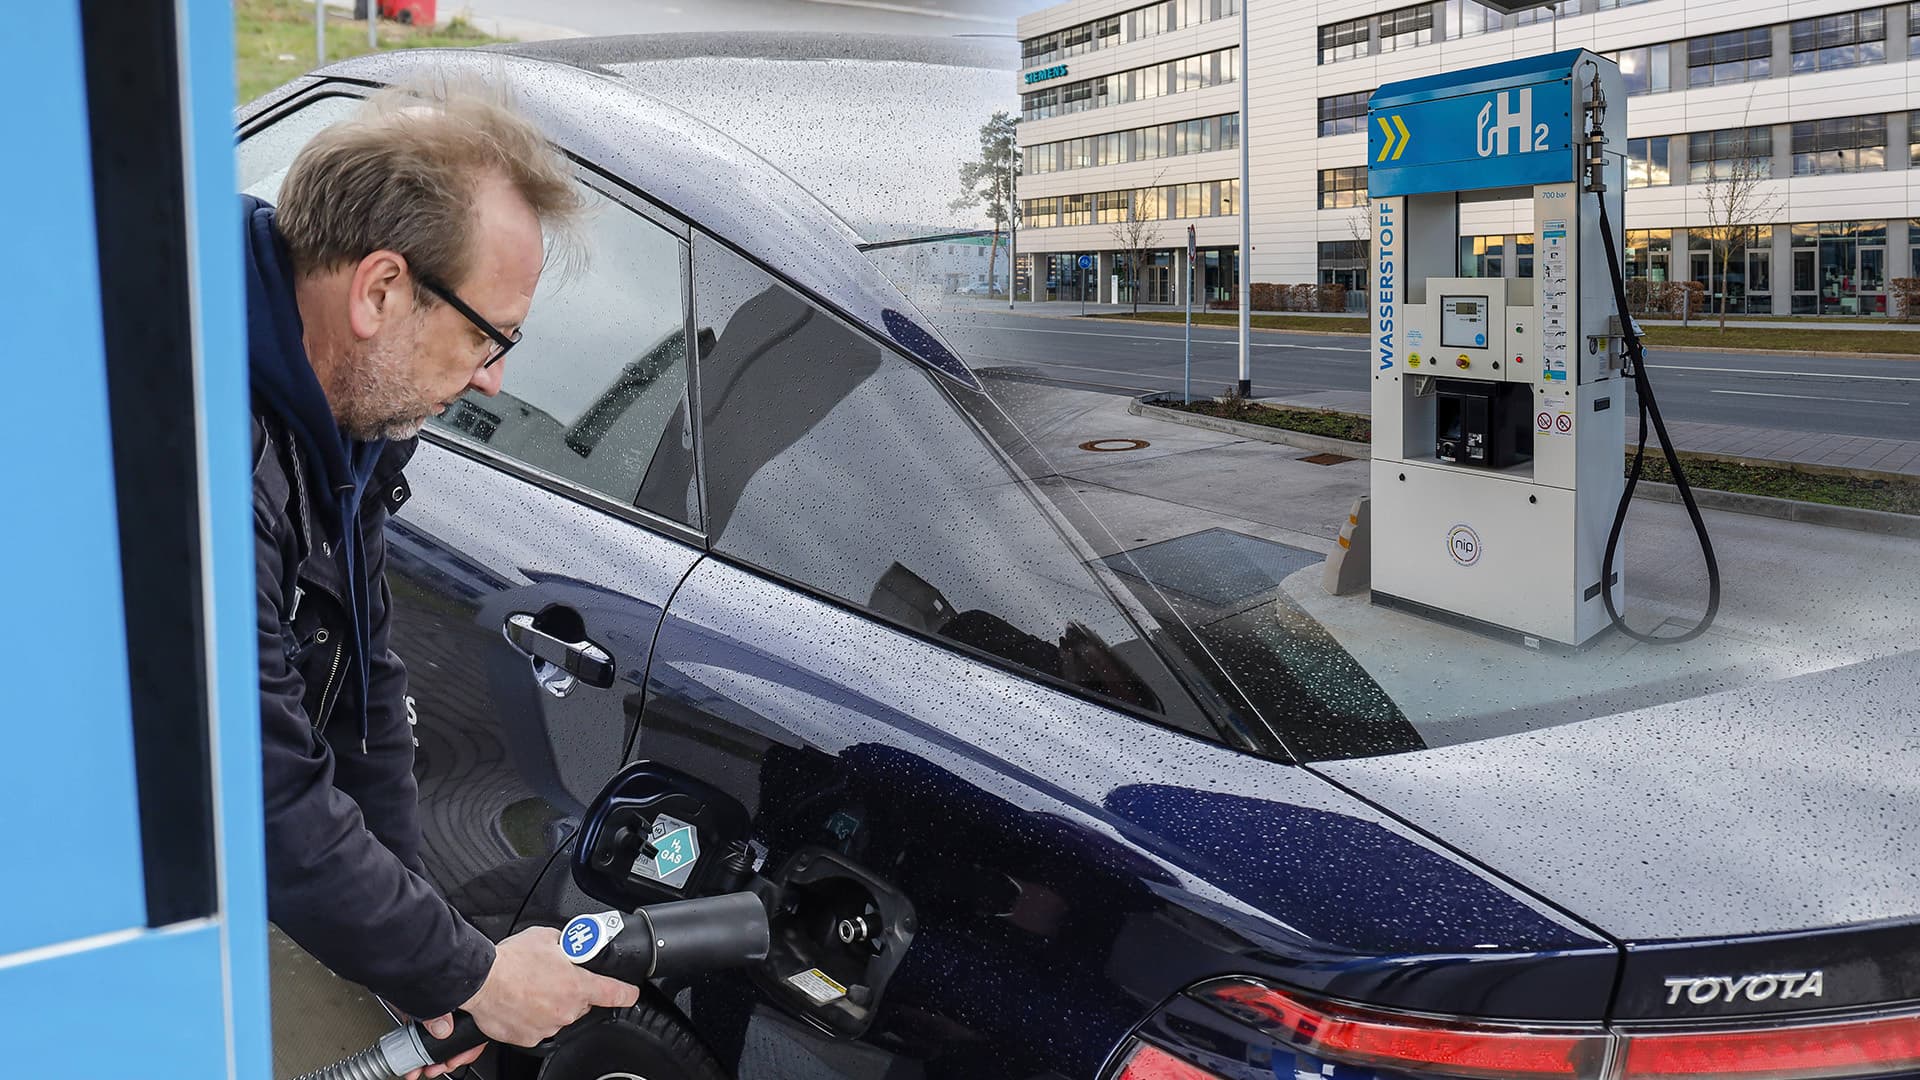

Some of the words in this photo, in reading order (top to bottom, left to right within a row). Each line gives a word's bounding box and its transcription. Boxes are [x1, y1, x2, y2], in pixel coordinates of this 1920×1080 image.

[1024, 64, 1068, 84] SIEMENS
[1542, 191, 1554, 199] 700
[1556, 191, 1567, 199] bar
[1380, 203, 1395, 370] WASSERSTOFF
[1455, 539, 1473, 553] nip
[671, 839, 682, 853] H2
[661, 850, 682, 864] GAS
[1664, 970, 1823, 1005] TOYOTA
